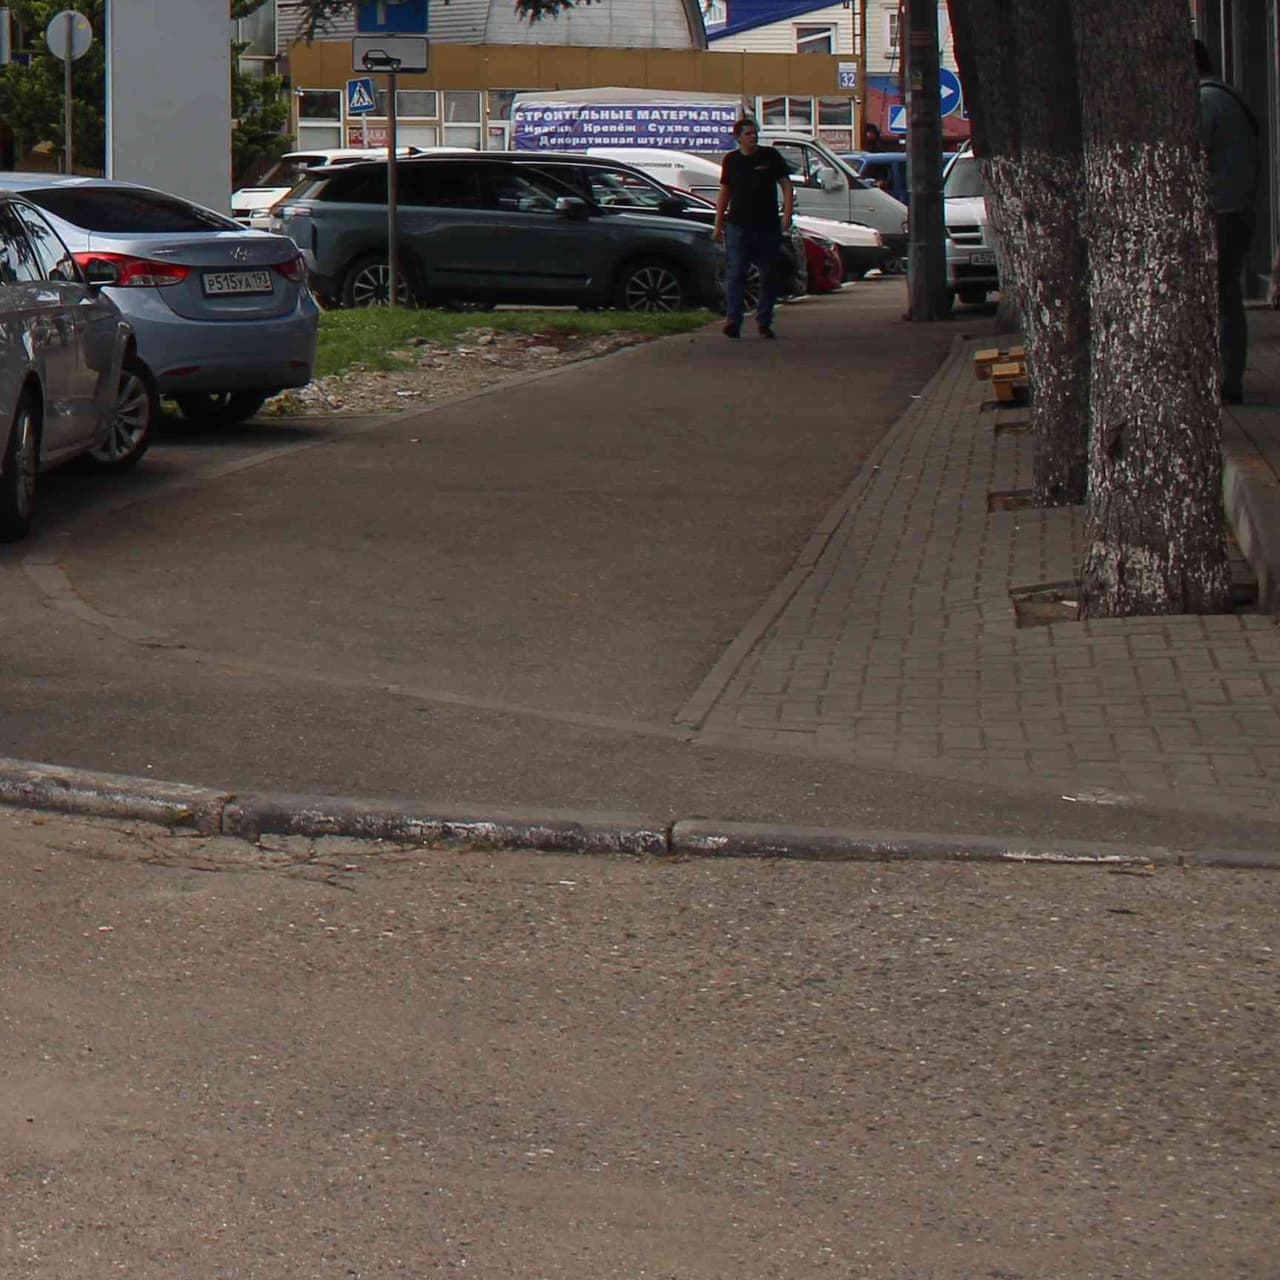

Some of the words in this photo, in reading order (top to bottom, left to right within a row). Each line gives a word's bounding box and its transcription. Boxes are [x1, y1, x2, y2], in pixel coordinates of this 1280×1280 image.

[841, 72, 855, 87] 32
[516, 109, 633, 121] СТРОИТЕЛЬНЫЕ
[636, 110, 735, 121] МАТЕРИАЛЫ
[583, 122, 636, 133] Крепёж
[647, 122, 690, 134] Сухие
[539, 135, 634, 146] Декоративная
[637, 136, 720, 146] штукатурка
